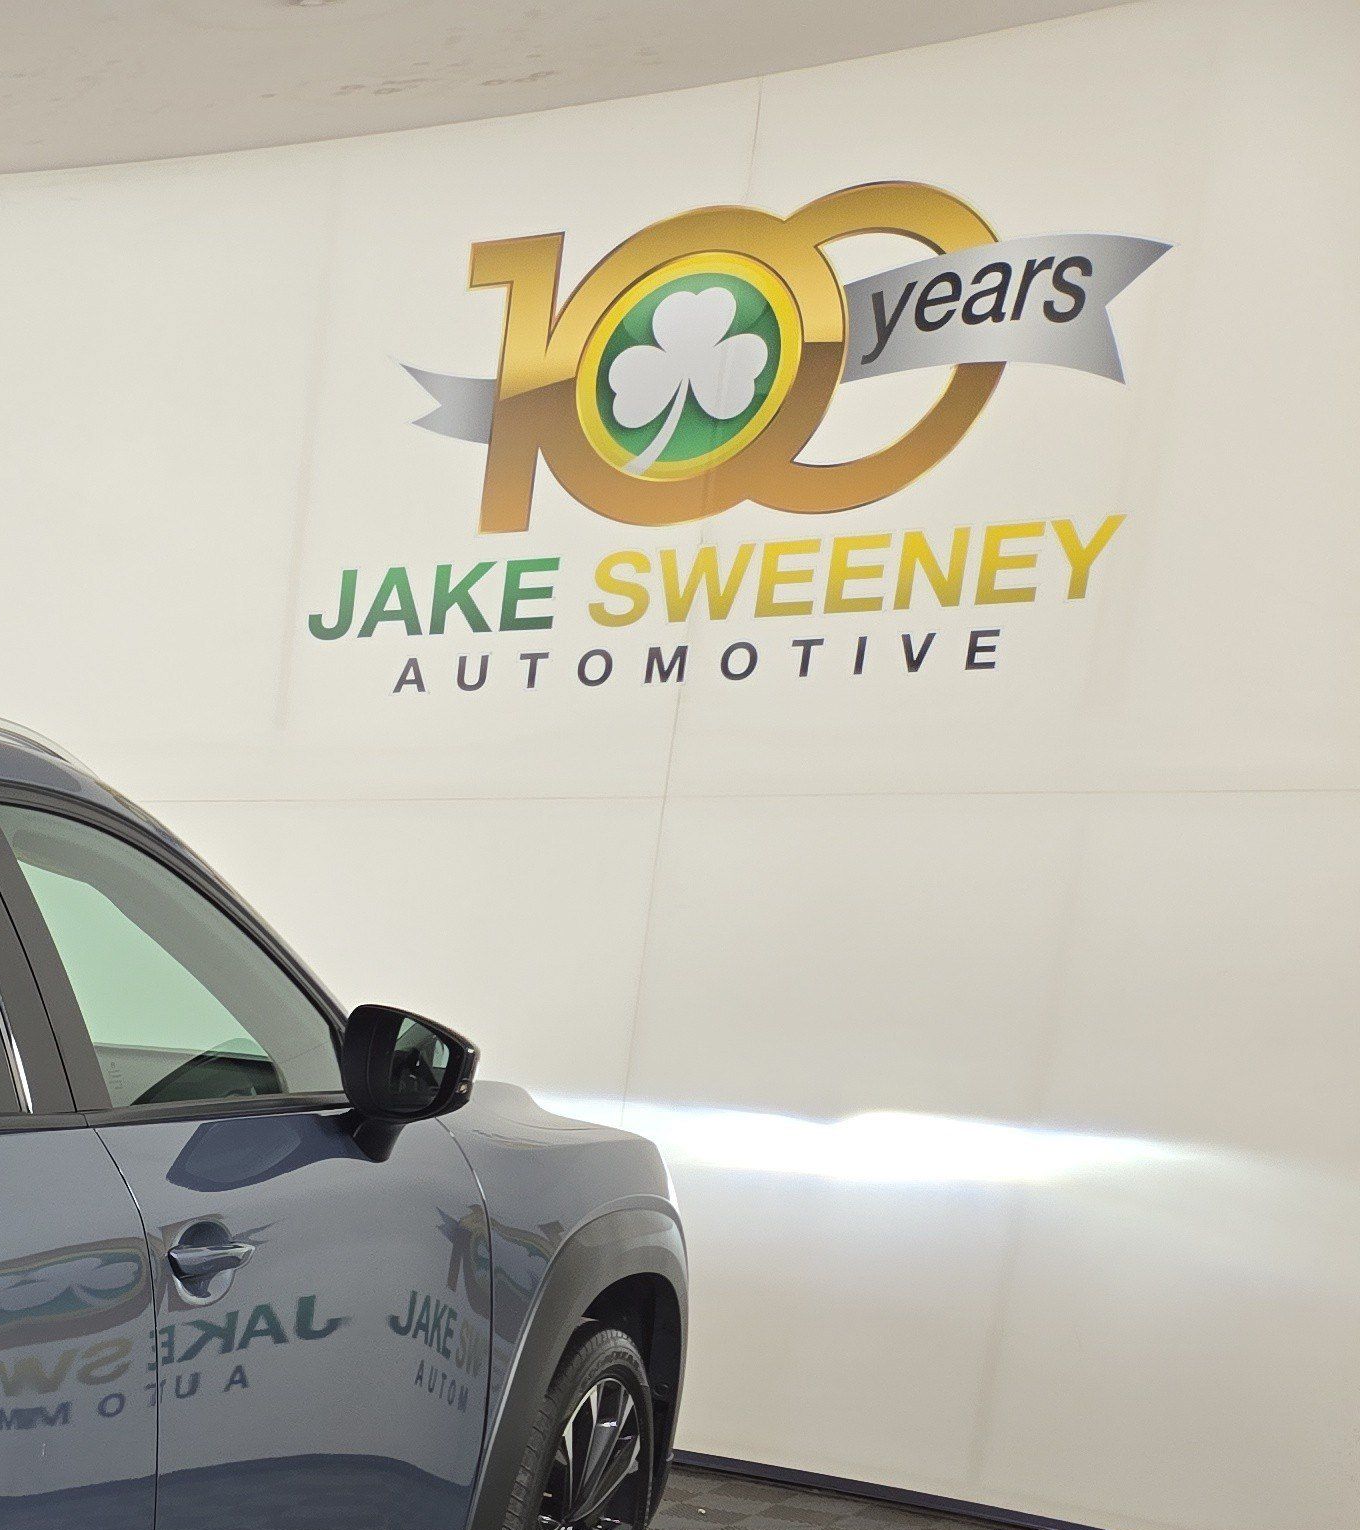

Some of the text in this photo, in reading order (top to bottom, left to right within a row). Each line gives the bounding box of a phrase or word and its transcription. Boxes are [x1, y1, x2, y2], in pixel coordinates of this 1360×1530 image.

[859, 253, 1094, 365] years
[308, 513, 1126, 640] JAKE SWEENEY
[393, 627, 1003, 695] AUTOMOTIVE
